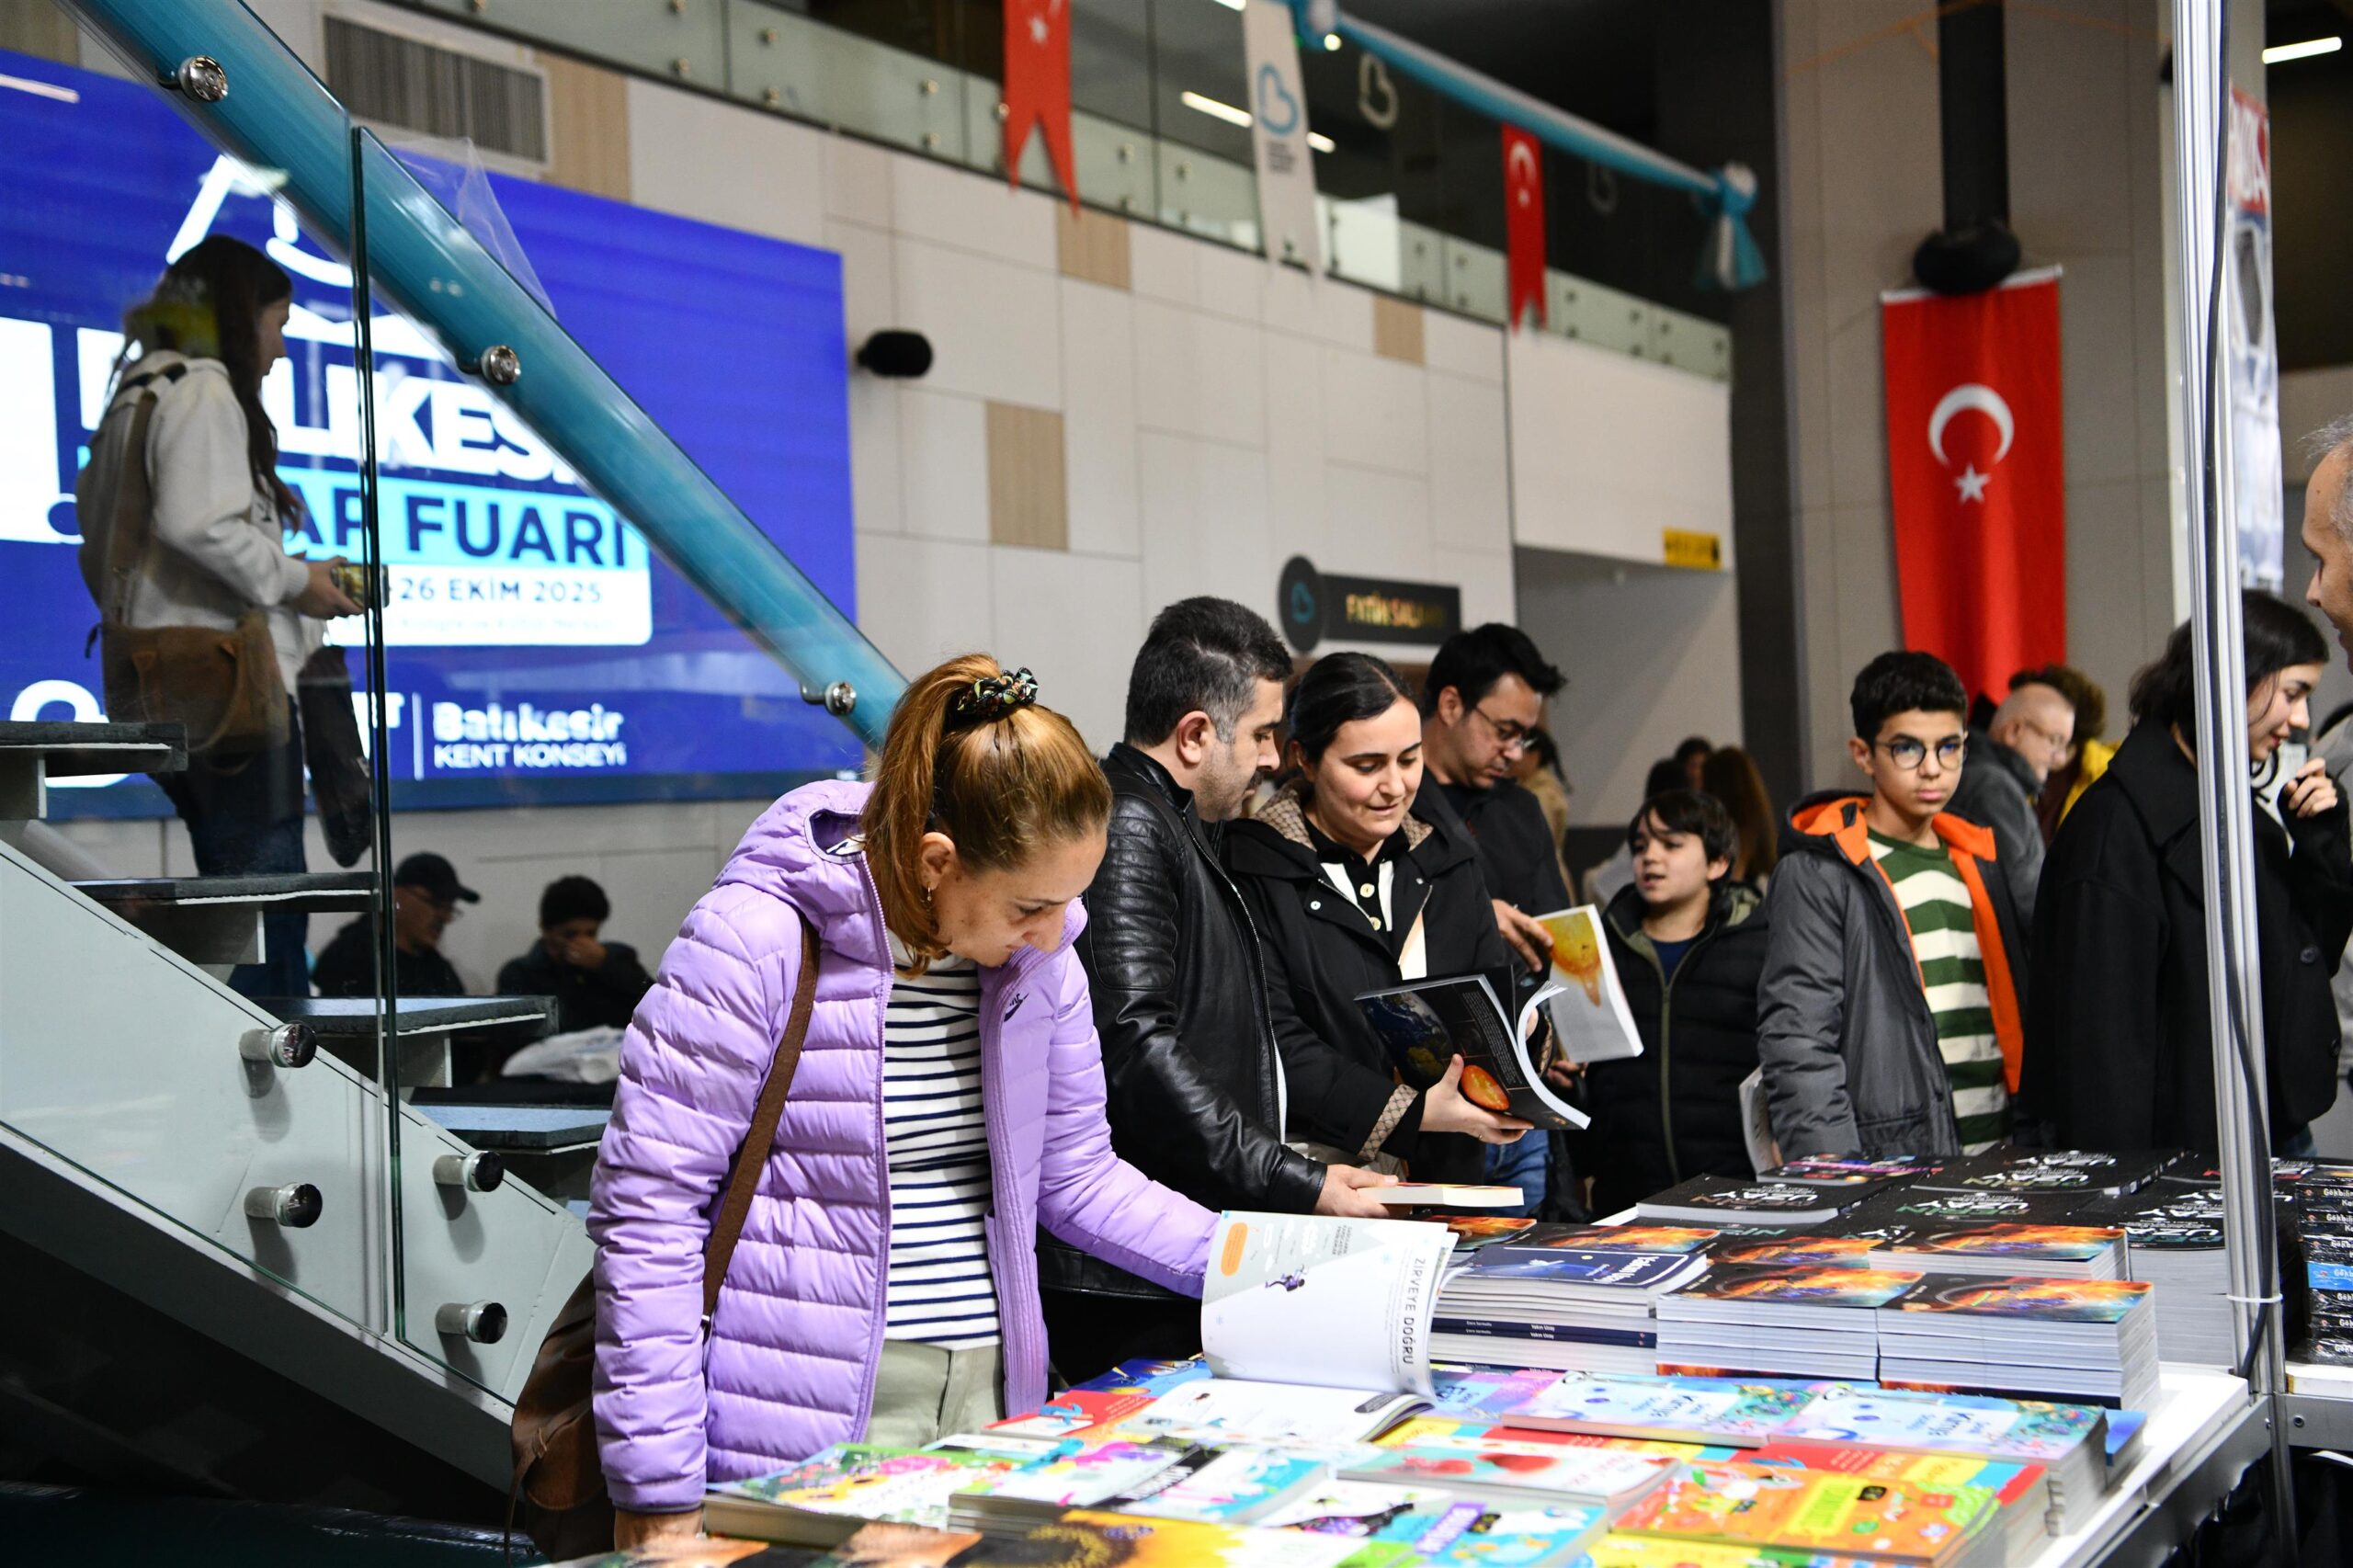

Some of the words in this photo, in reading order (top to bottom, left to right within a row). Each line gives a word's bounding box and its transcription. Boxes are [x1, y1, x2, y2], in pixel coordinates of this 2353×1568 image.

[405, 494, 625, 567] FUARI
[400, 577, 435, 600] 26
[449, 575, 520, 602] EKİM
[533, 580, 602, 602] 2025
[434, 744, 509, 768] KENT
[1915, 1199, 2029, 1210] UZAY
[2134, 1208, 2223, 1219] ZAY
[1402, 1316, 1417, 1365] DOĞRU
